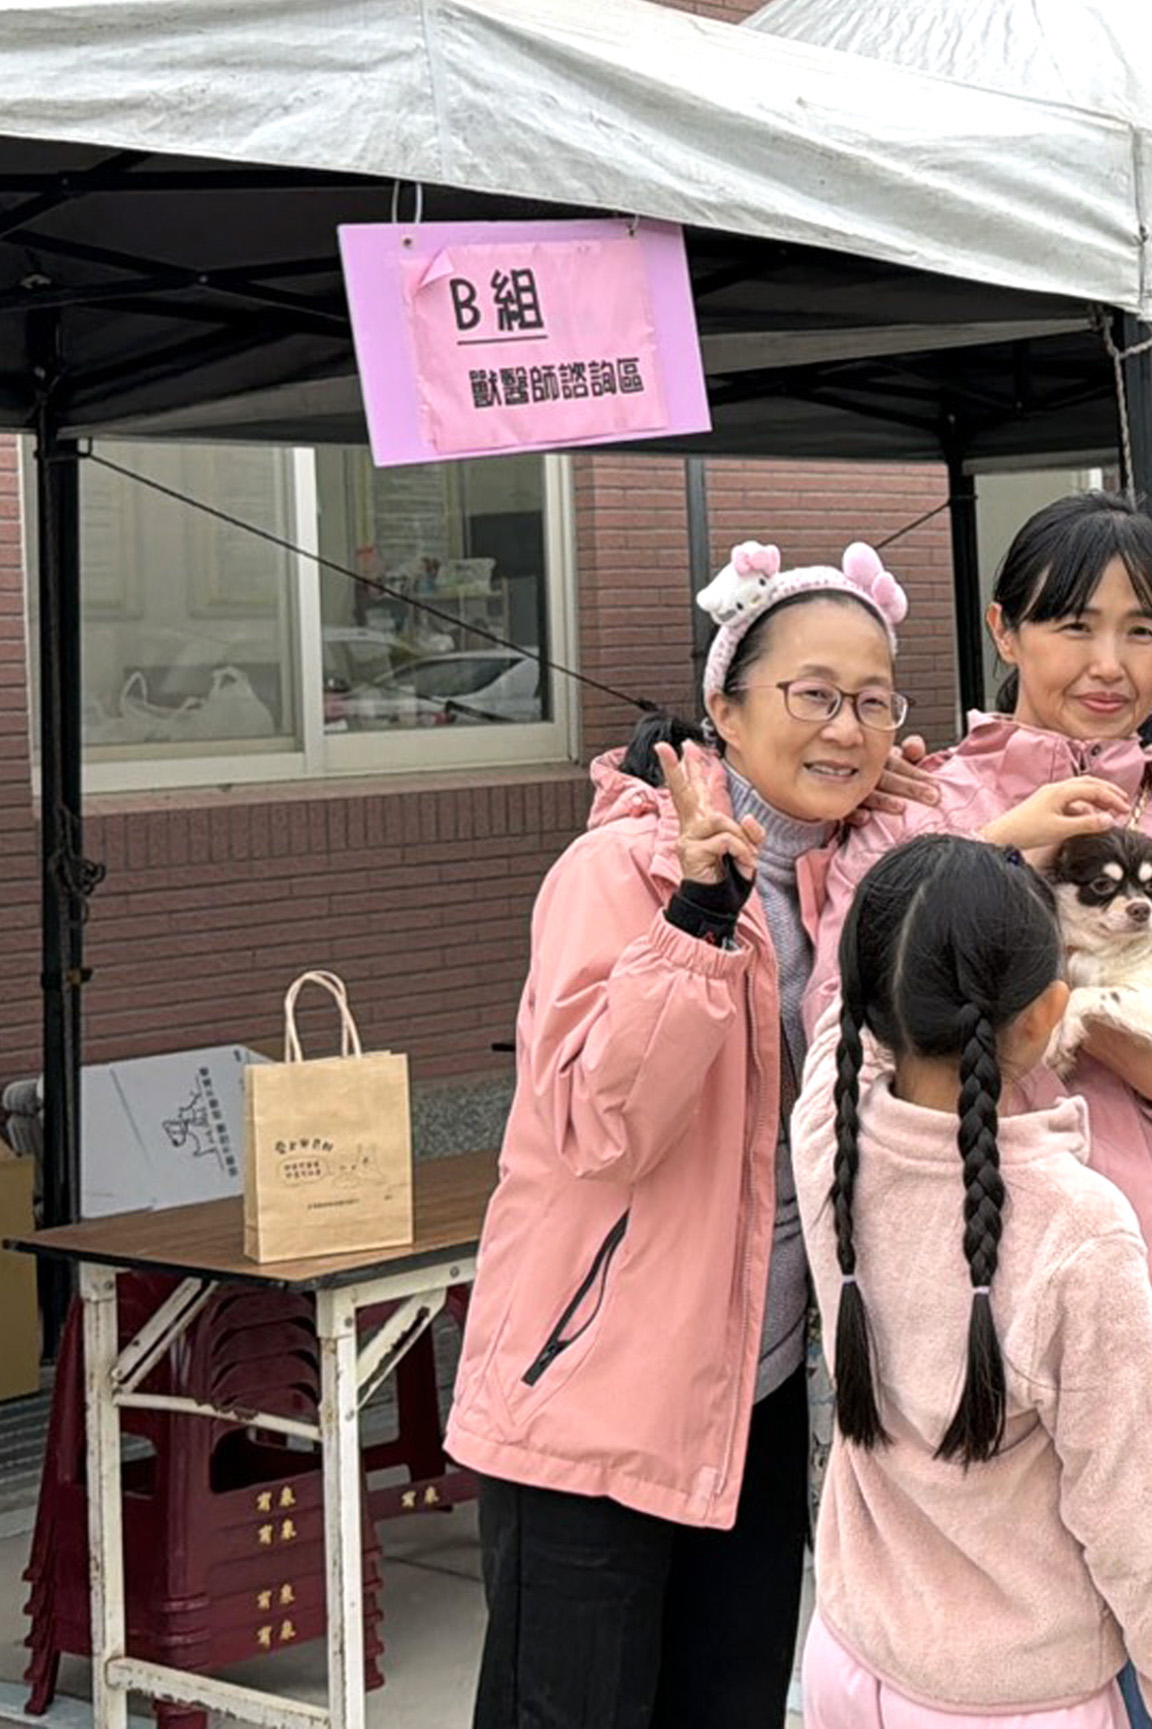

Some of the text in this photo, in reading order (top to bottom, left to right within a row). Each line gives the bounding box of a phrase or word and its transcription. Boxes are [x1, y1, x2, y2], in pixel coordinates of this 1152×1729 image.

[450, 268, 544, 331] B 組
[469, 357, 644, 408] 獸醫師諮詢區
